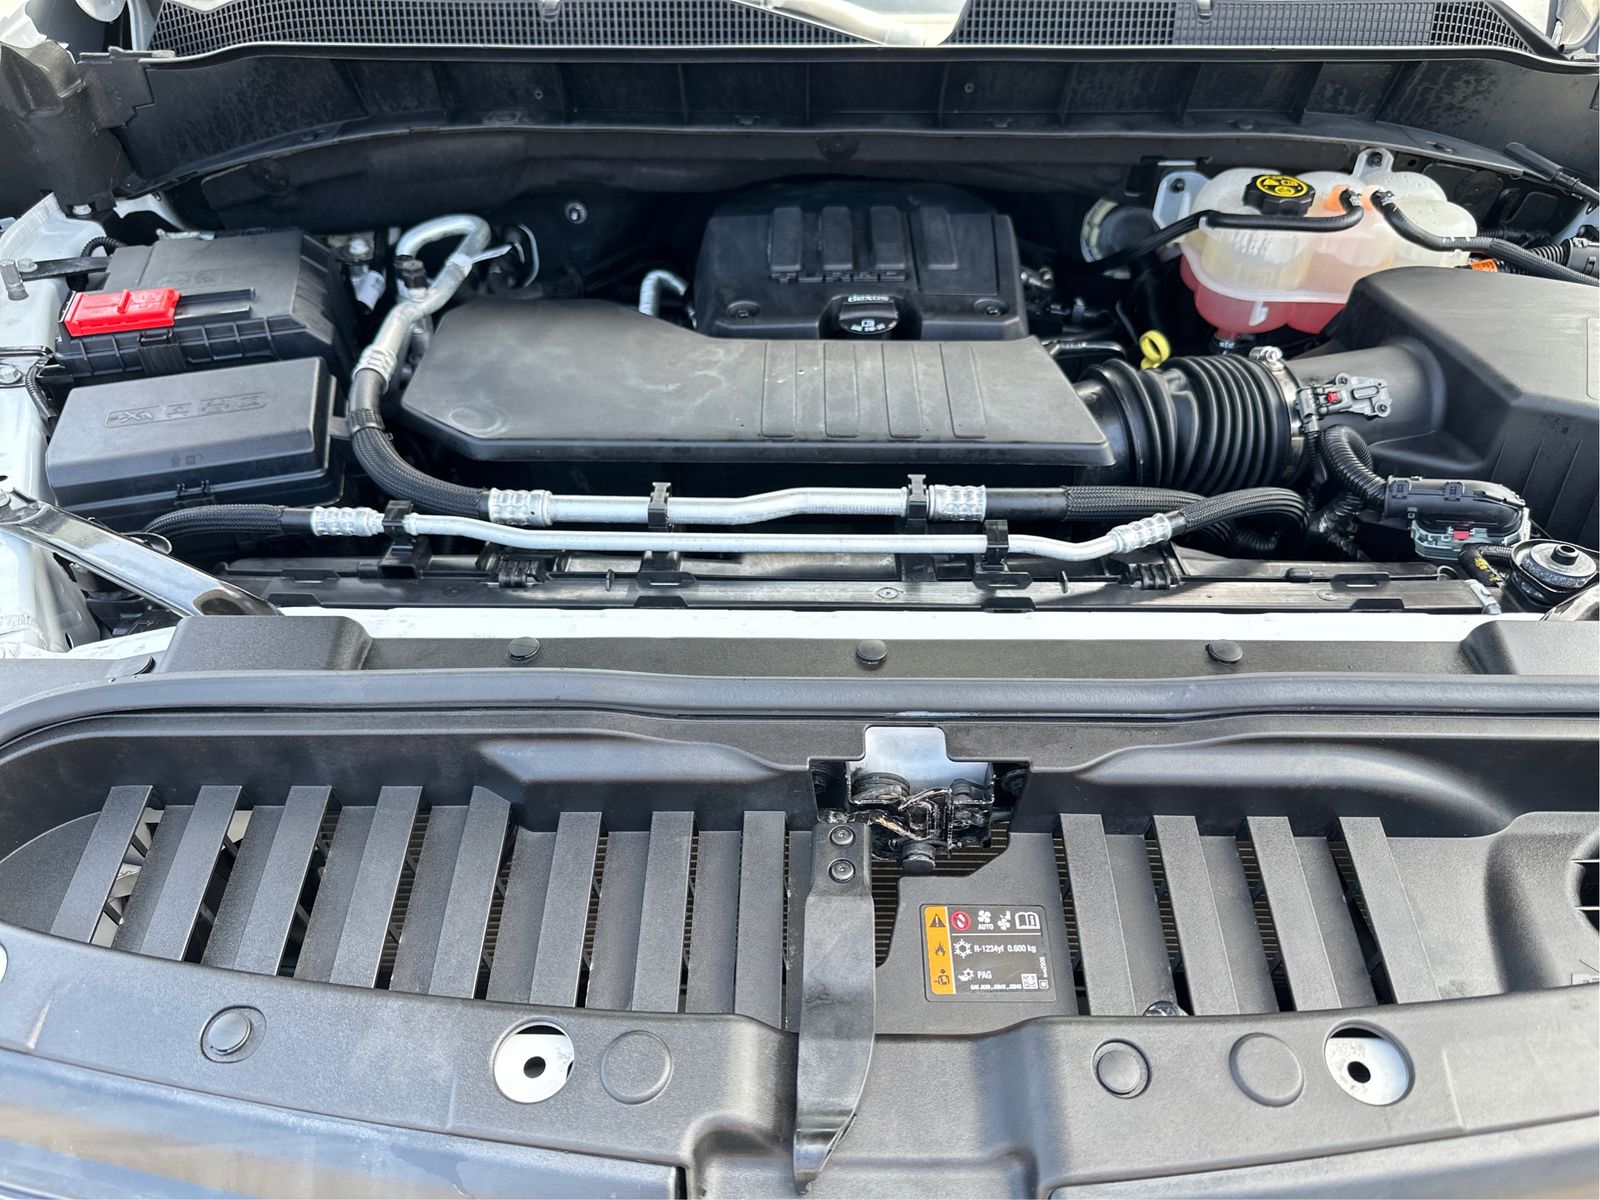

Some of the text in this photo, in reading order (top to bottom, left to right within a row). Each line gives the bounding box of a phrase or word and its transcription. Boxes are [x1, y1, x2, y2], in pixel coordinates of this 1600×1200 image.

[974, 944, 1004, 954] R-1234yf
[1027, 944, 1037, 954] kg
[977, 970, 992, 980] PAG
